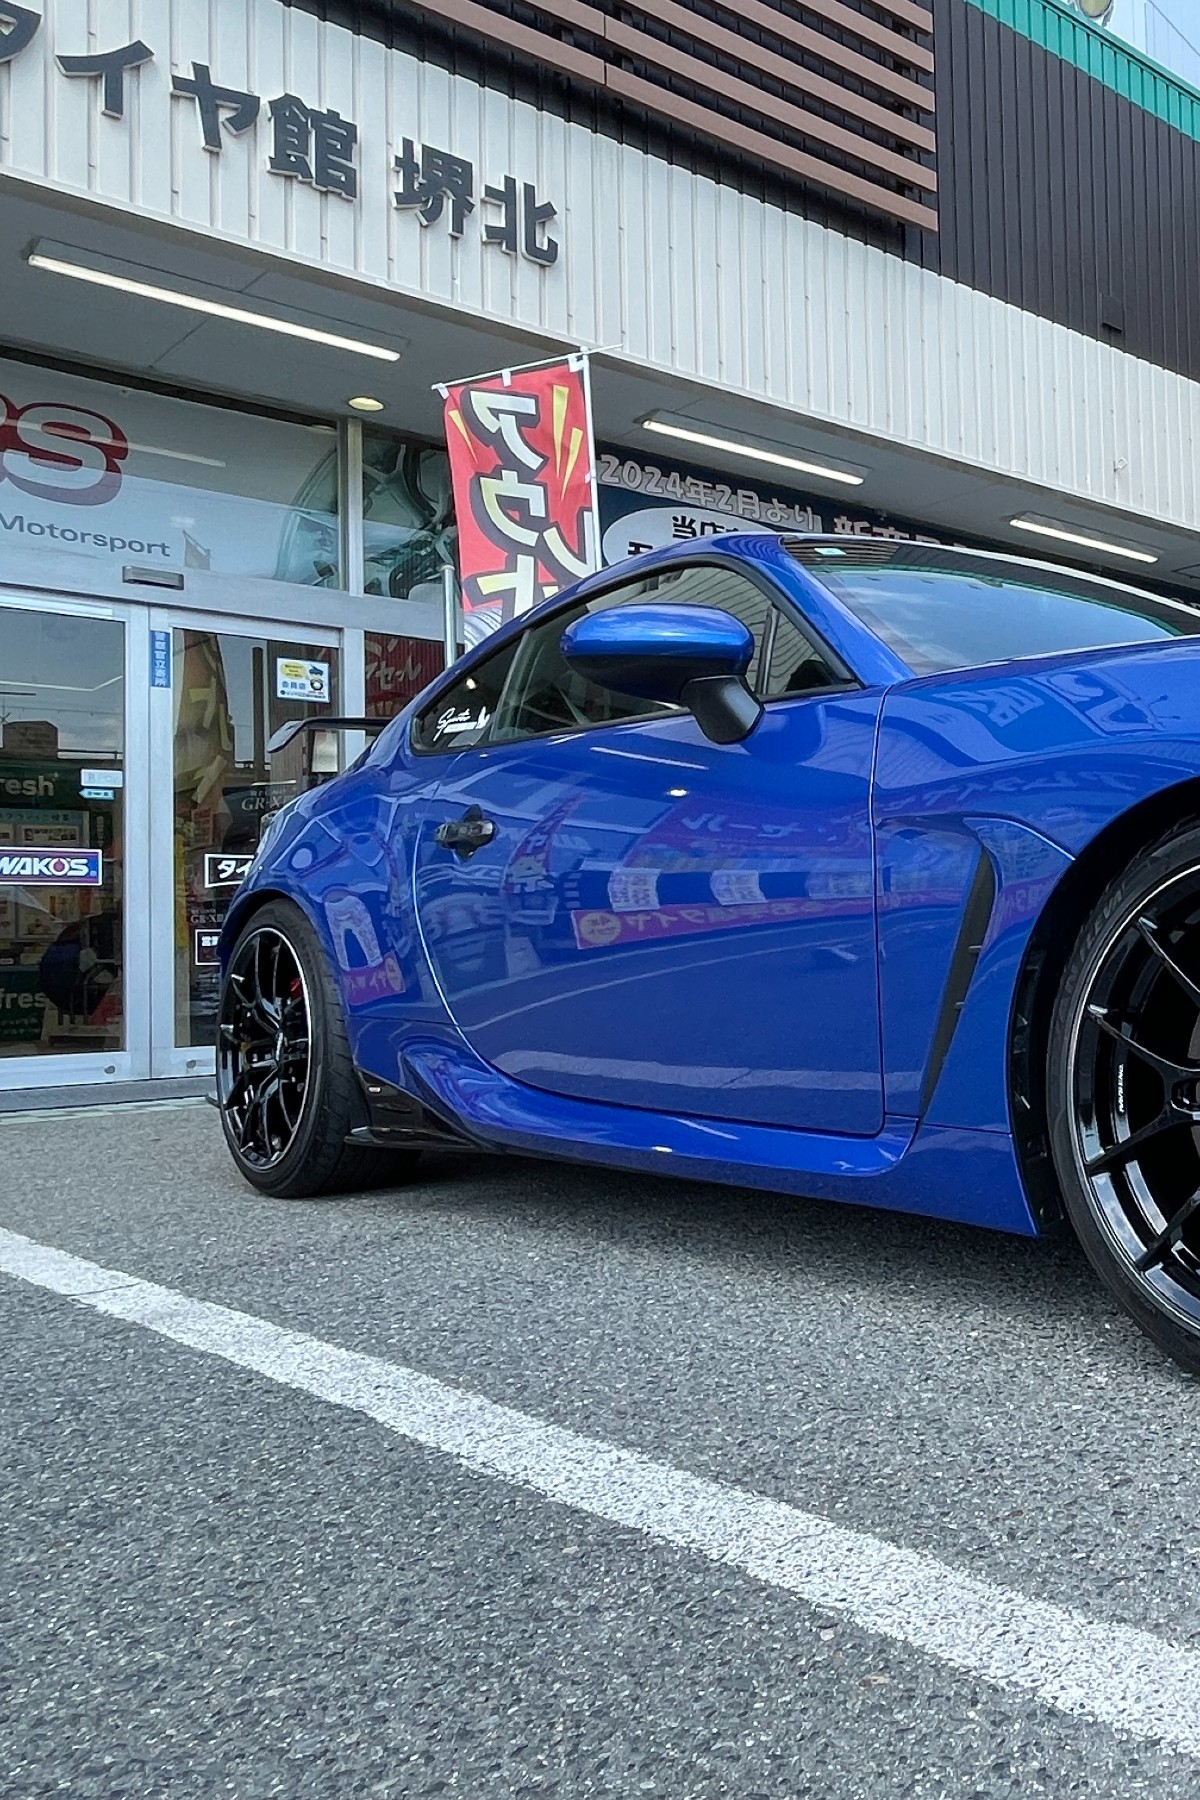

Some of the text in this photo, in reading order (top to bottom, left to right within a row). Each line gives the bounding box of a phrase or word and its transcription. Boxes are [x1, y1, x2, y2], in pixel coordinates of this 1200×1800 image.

[394, 137, 559, 267] 堺北
[0, 393, 128, 506] S
[600, 454, 813, 531] 2024年2月より
[0, 512, 171, 557] Motorsport
